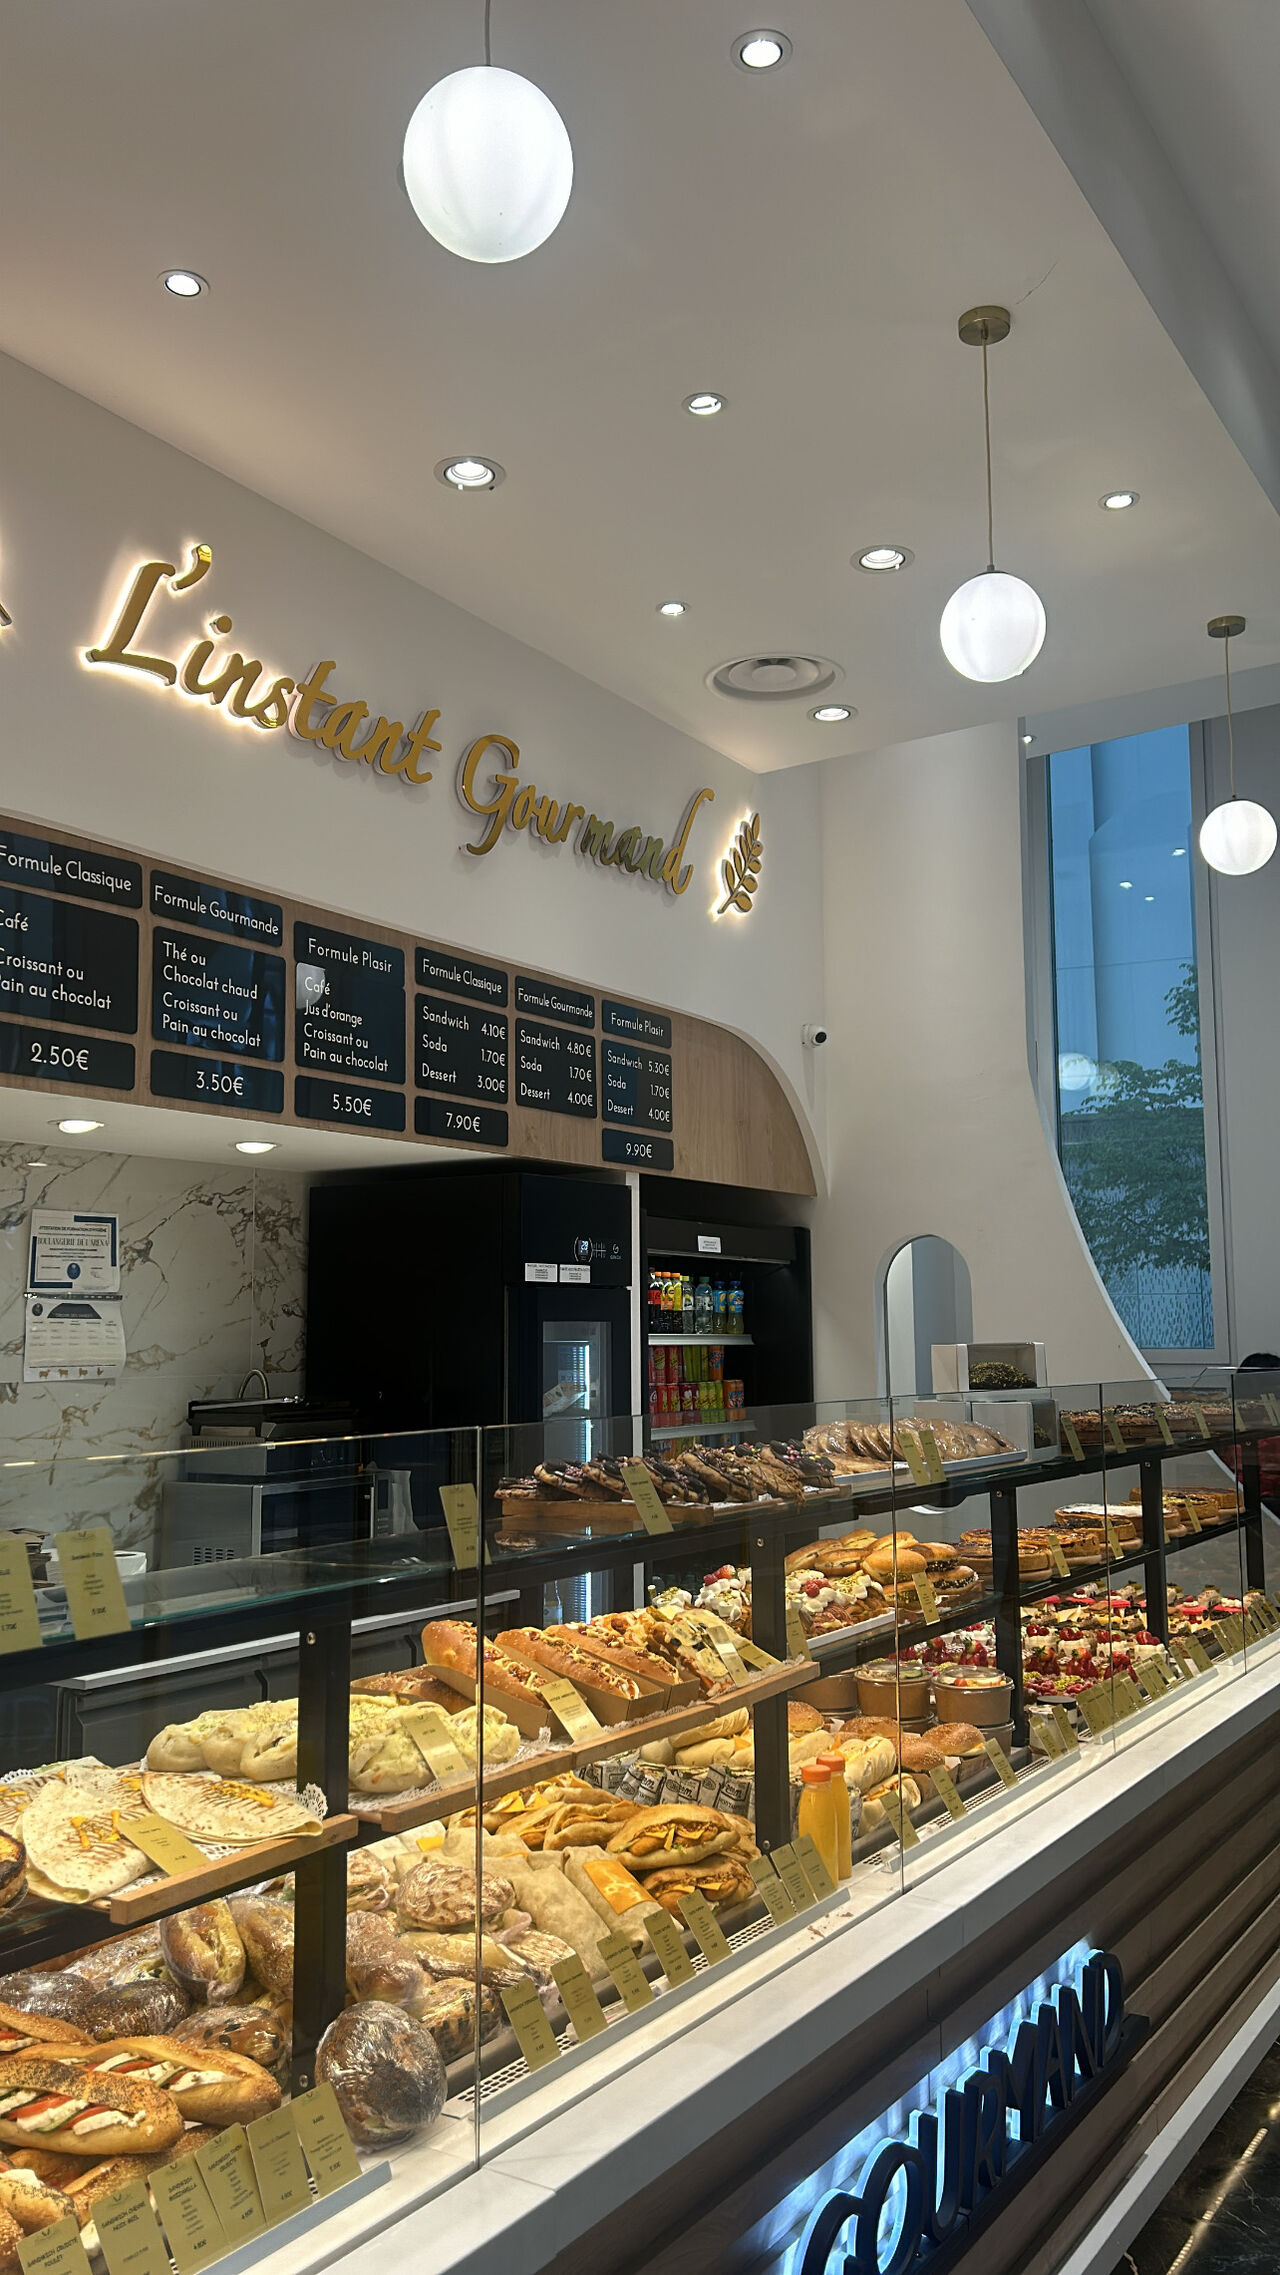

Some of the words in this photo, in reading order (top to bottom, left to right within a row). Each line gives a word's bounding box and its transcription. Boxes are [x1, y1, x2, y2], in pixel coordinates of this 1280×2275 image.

[86, 543, 441, 783] L'instant
[456, 734, 714, 895] Gourmand
[66, 860, 132, 892] Classique
[154, 885, 206, 914] Formule
[210, 901, 279, 935] Gourmande
[163, 941, 187, 961] Thé
[191, 955, 206, 966] ou
[308, 938, 358, 964] Formule
[362, 951, 392, 973] Plasir
[66, 967, 84, 980] ou
[163, 965, 219, 991] Chocolat
[222, 978, 258, 1000] chaud
[304, 976, 330, 996] Café
[423, 958, 461, 982] Formule
[463, 970, 502, 995] Classique
[0, 974, 24, 994] ain
[29, 985, 47, 998] au
[52, 984, 112, 1010] chocolat
[162, 991, 220, 1018] Croissant
[223, 1010, 238, 1021] ou
[518, 987, 550, 1008] Formule
[550, 996, 593, 1018] Gourmande
[304, 1000, 320, 1017] Jus
[321, 1002, 363, 1028] d'orange
[422, 1005, 470, 1031] Sandwich
[480, 1023, 506, 1040] 4.10€
[611, 1012, 642, 1032] Formule
[644, 1020, 664, 1037] Plasir
[162, 1014, 188, 1034] Pain
[192, 1026, 207, 1037] au
[210, 1023, 261, 1048] chocolat
[304, 1023, 354, 1046] Croissant
[356, 1038, 369, 1049] ou
[520, 1029, 560, 1051] Sandwich
[567, 1041, 592, 1058] 4.80€
[30, 1042, 89, 1070] 2.50€
[304, 1042, 326, 1061] Pain
[330, 1053, 342, 1064] au
[345, 1050, 388, 1072] chocolat
[422, 1033, 448, 1053] Soda
[480, 1048, 506, 1067] 1.70€
[608, 1050, 643, 1070] Sandwich
[648, 1060, 670, 1077] 5.30€
[422, 1062, 456, 1083] Dessert
[477, 1075, 506, 1093] 3.00€
[520, 1055, 542, 1072] Soda
[569, 1066, 592, 1082] 1.70€
[196, 1070, 244, 1096] 3.50€
[520, 1082, 550, 1100] Dessert
[568, 1091, 593, 1107] 4.00€
[608, 1074, 626, 1090] Soda
[650, 1084, 670, 1099] 1.70€
[332, 1093, 372, 1117] 5.50€
[608, 1099, 634, 1116] Dessert
[648, 1107, 670, 1123] 4.00€
[446, 1112, 481, 1133] 7.90€
[626, 1142, 652, 1158] 9.90€
